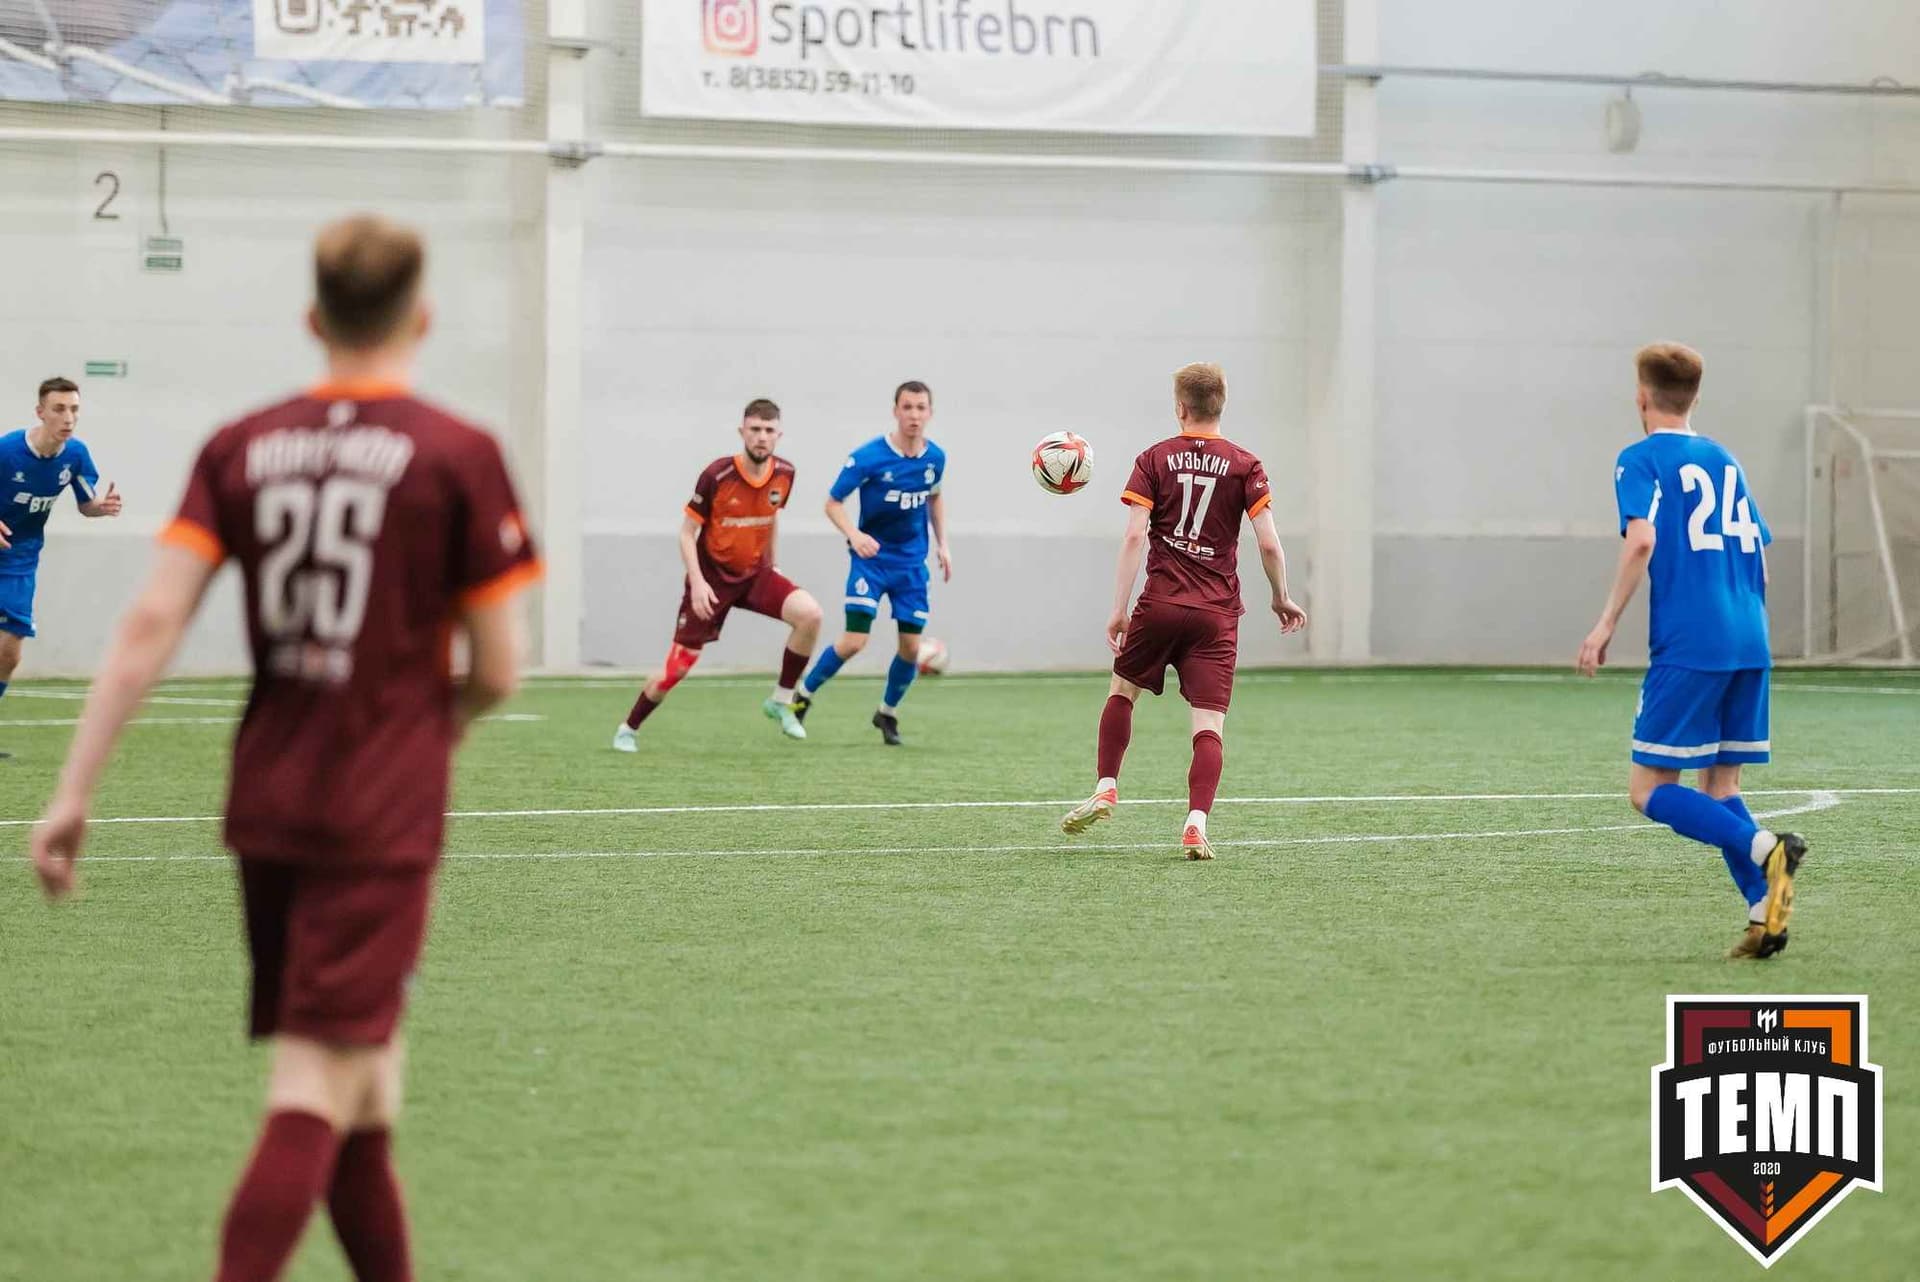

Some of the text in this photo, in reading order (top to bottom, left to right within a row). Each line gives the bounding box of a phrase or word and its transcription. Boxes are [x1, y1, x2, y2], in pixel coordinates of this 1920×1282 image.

[769, 0, 1099, 59] sportlifebrn
[729, 66, 818, 95] 8(3852)
[94, 172, 120, 220] 2
[1166, 451, 1231, 477] КУЗЬКИН
[1173, 473, 1217, 541] 17
[1679, 463, 1760, 554] 24
[253, 479, 389, 641] 25
